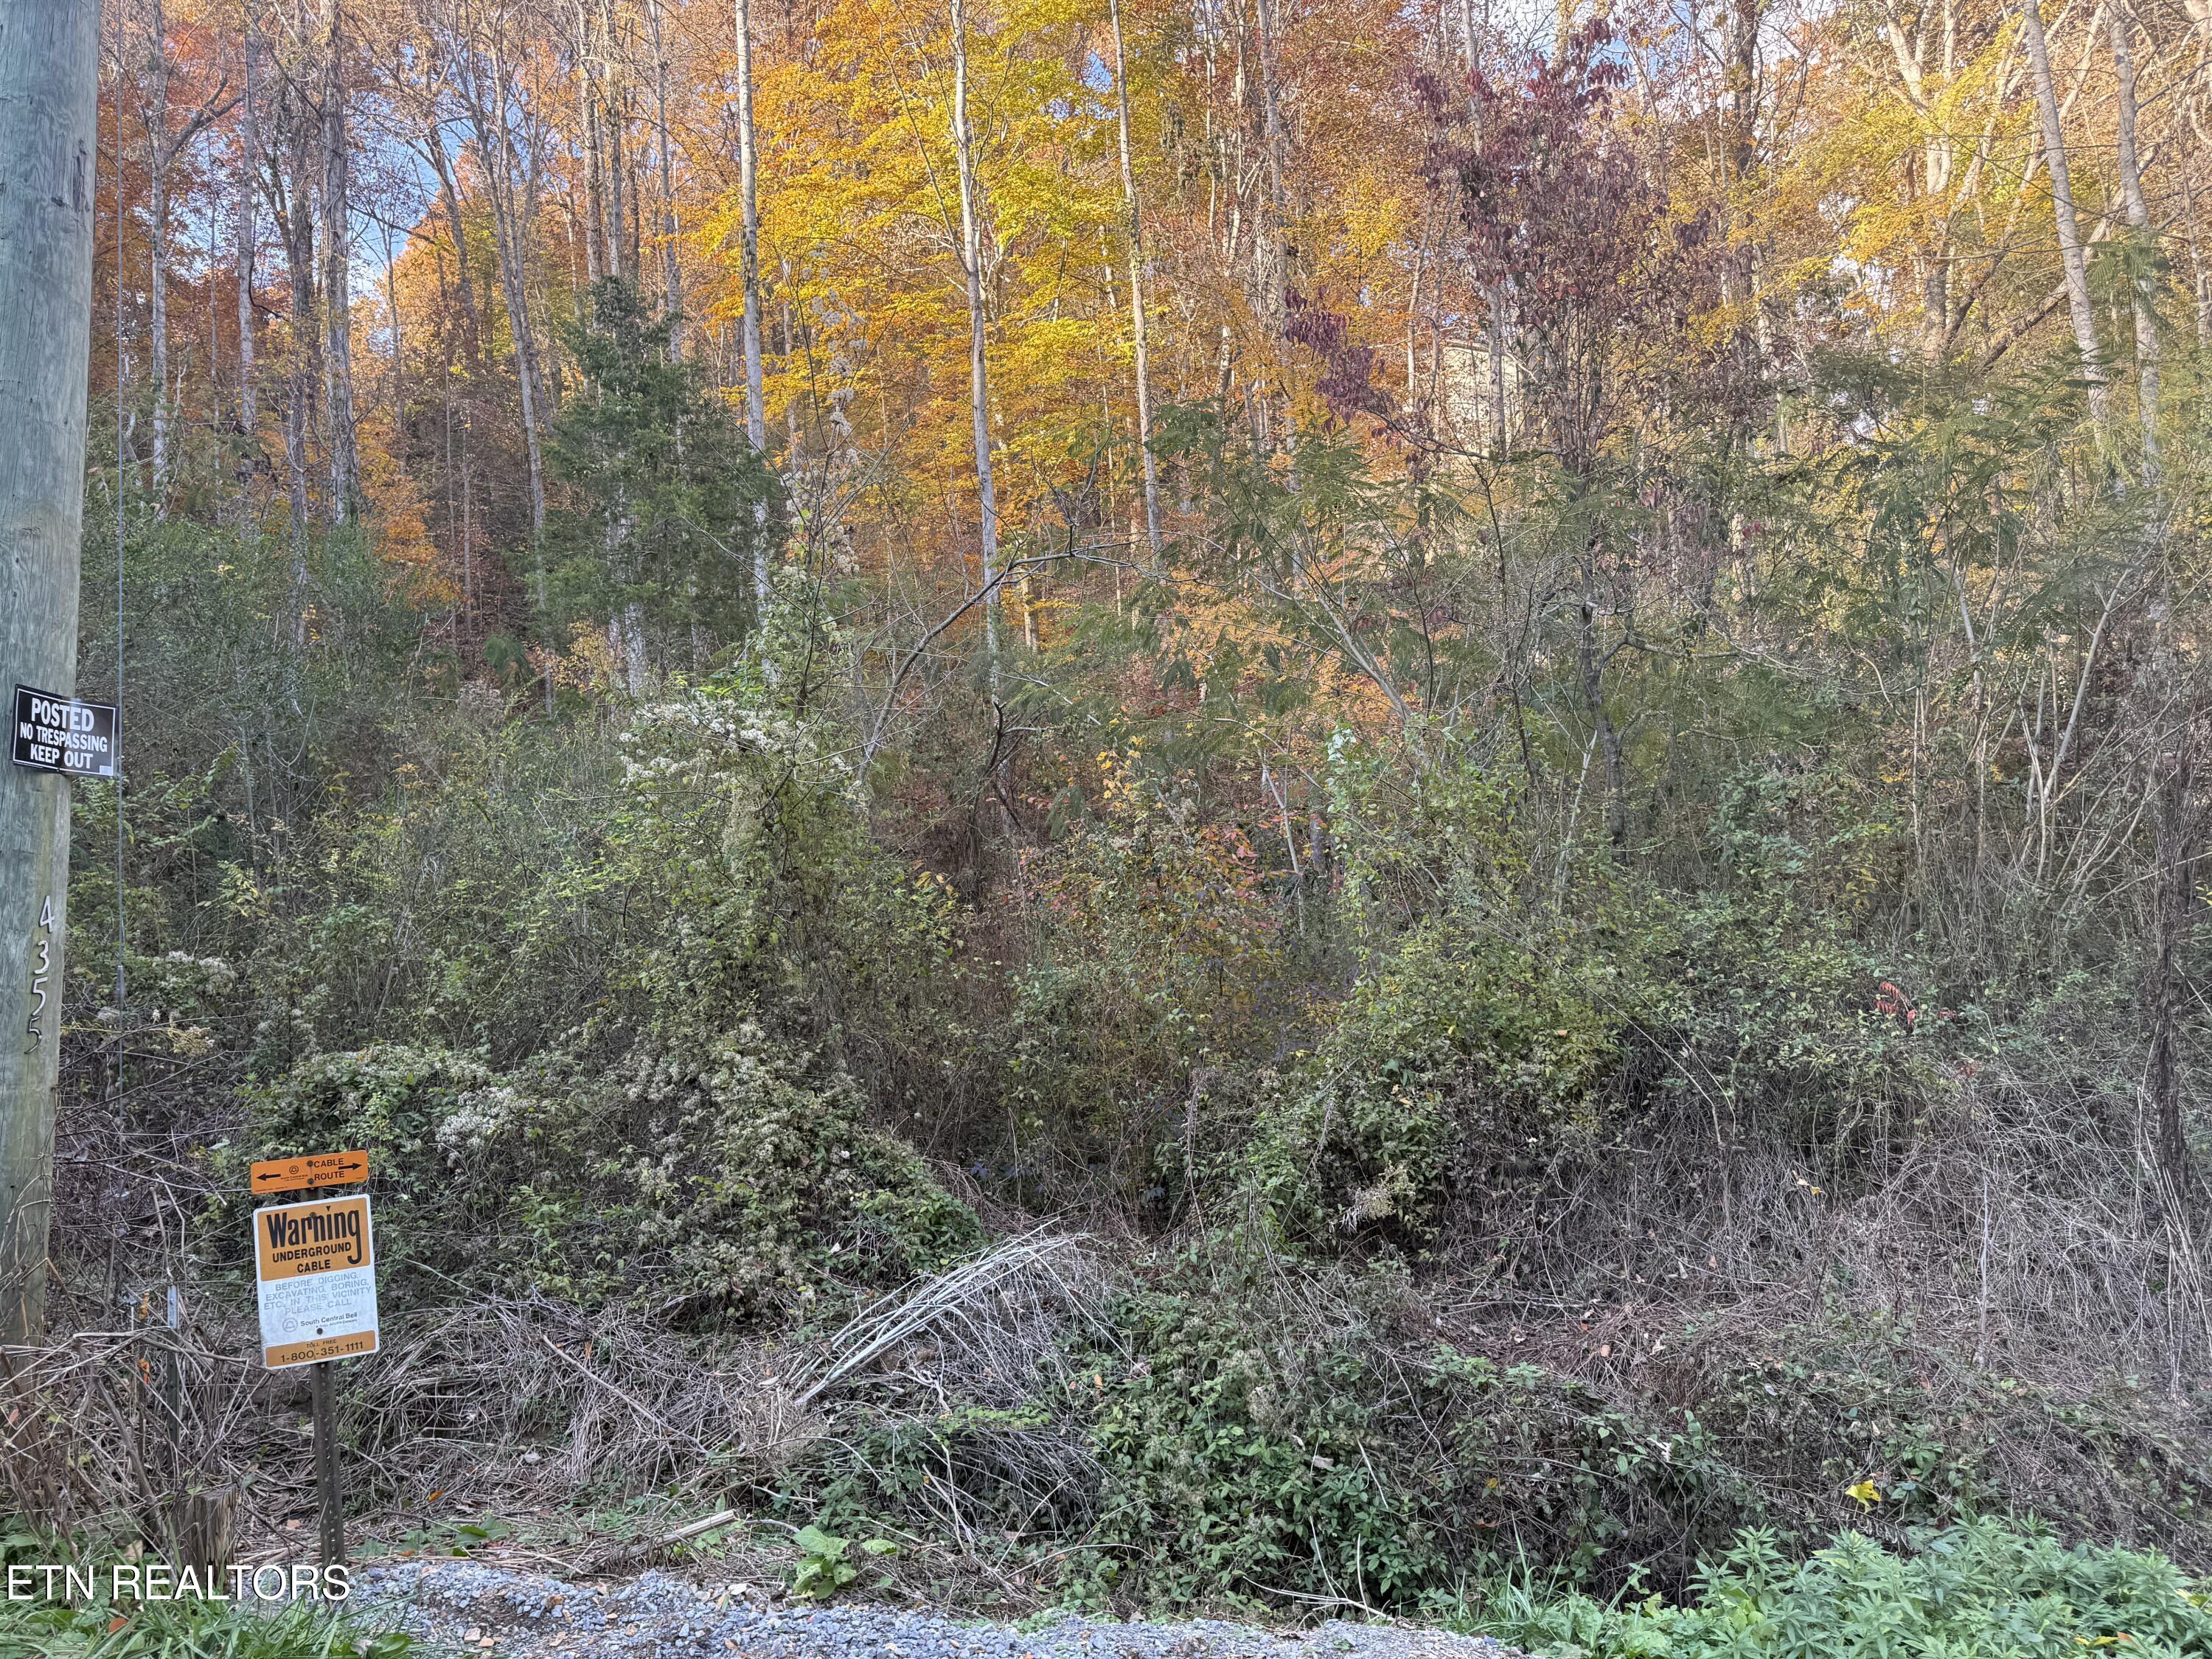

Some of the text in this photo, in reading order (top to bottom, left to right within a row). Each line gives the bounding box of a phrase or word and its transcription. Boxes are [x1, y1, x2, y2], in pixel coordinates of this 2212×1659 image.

[31, 698, 94, 731] POSTED
[20, 722, 108, 752] NO TRESPASSING
[30, 744, 94, 768] KEEP OUT
[24, 895, 55, 1054] 4355
[313, 1158, 344, 1168] CABLE
[314, 1171, 345, 1180] ROUTE
[266, 1206, 362, 1265] Warning
[272, 1242, 352, 1262] UNDERGROUND
[297, 1259, 330, 1273] CABLE
[275, 1279, 313, 1291] BEFORE
[291, 1298, 300, 1306] IN
[306, 1293, 327, 1304] THIS
[333, 1286, 371, 1298] VICINITY
[285, 1298, 352, 1315] PLEASE CALL
[300, 1318, 320, 1326] South
[321, 1314, 344, 1323] Central
[280, 1341, 364, 1363] 1-800-351-1111
